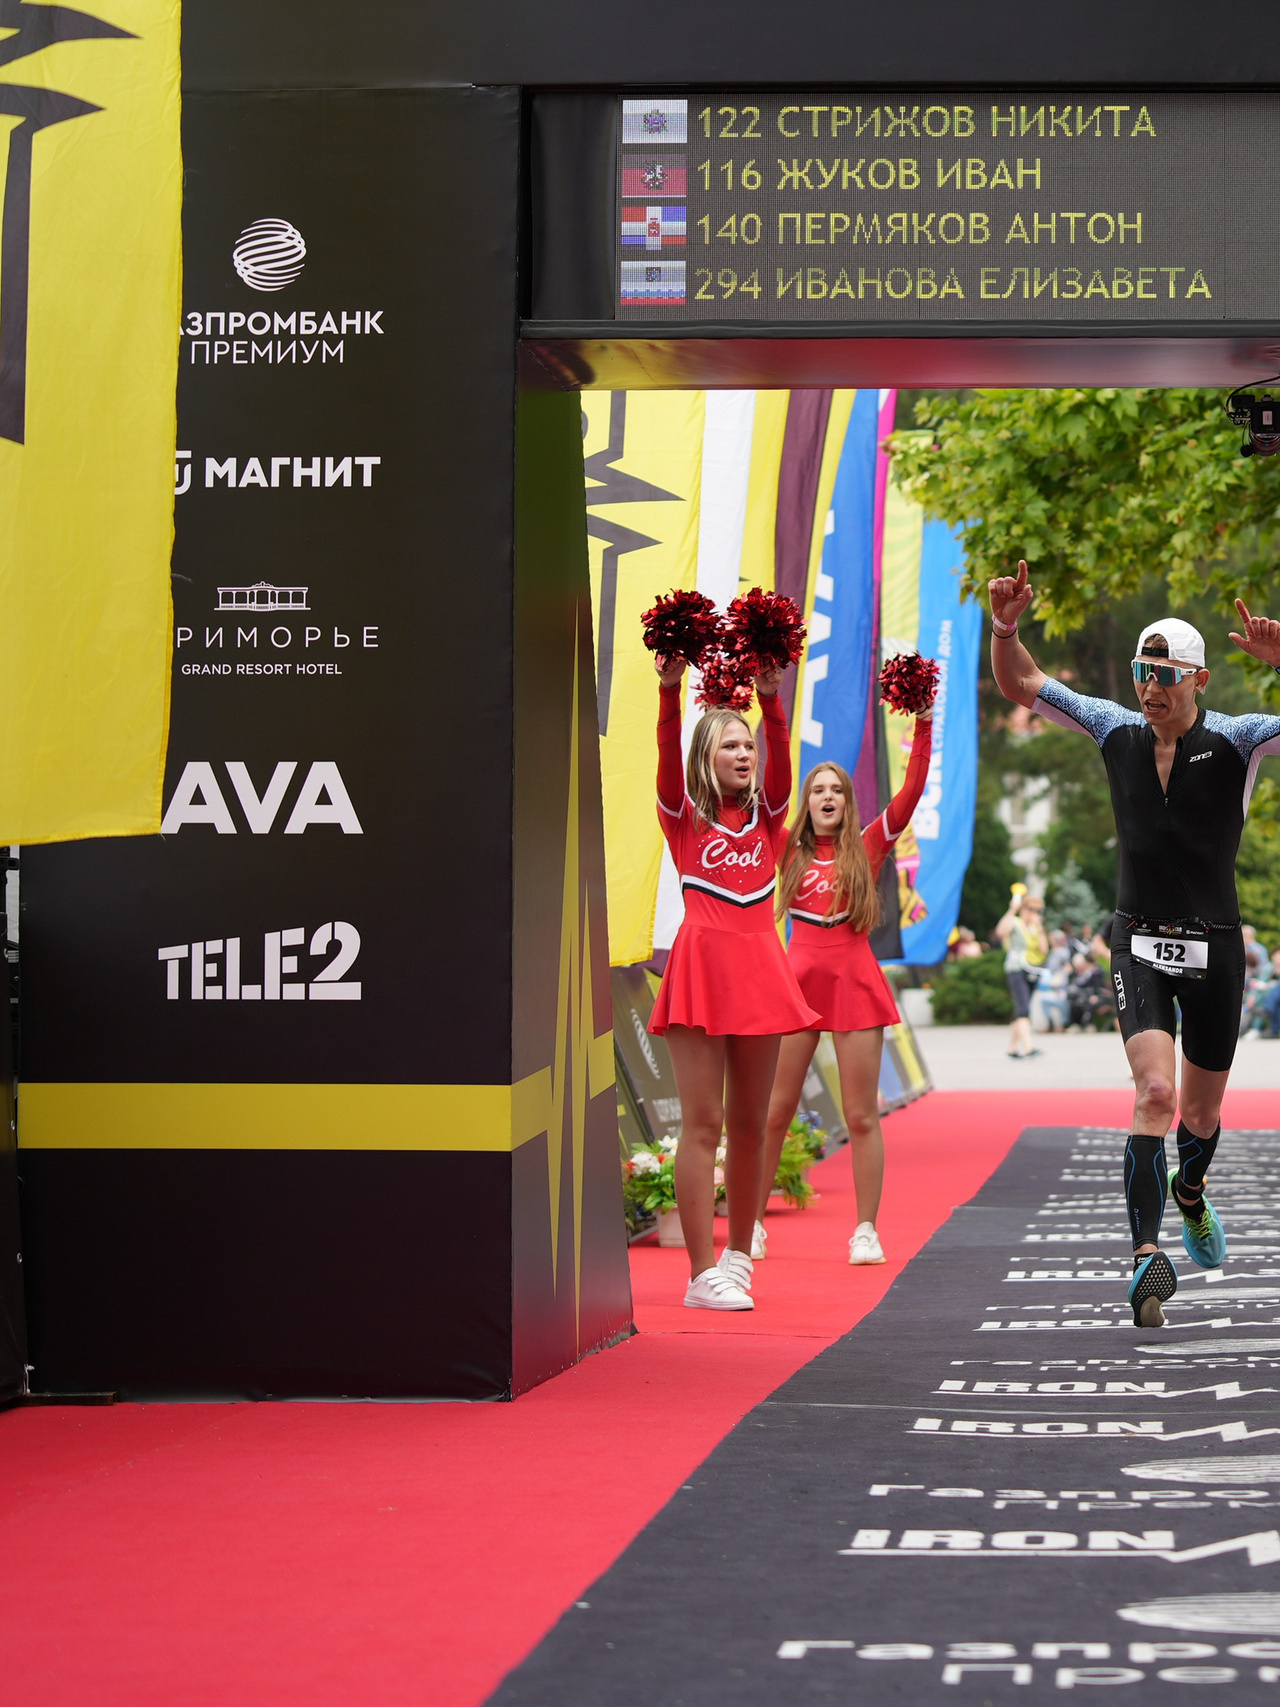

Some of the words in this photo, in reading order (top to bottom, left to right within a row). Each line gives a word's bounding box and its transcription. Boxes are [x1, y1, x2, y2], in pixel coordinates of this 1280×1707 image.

[696, 106, 762, 138] 122
[776, 105, 975, 138] СТРИЖОВ
[991, 104, 1156, 137] НИКИТА
[696, 159, 762, 191] 116
[776, 159, 921, 191] ЖУКОВ
[935, 158, 1042, 190] ИВАН
[697, 213, 762, 245] 140
[777, 213, 991, 245] ПЕРМЯКОВ
[1005, 212, 1143, 244] АНТОН
[694, 268, 762, 300] 294
[775, 267, 964, 300] ИВАНОВА
[980, 267, 1213, 299] ЕЛИЗАВЕТА
[178, 310, 385, 336] ЗПРОМБАНК
[190, 340, 345, 365] ПРЕМИУМ
[204, 456, 381, 488] МАГНИТ
[176, 626, 380, 649] РИМОРЬЕ
[181, 663, 232, 676] GRAND
[236, 663, 292, 676] RESORT
[296, 663, 342, 676] HOTEL
[160, 761, 364, 834] AVA
[701, 838, 762, 869] Cool
[158, 921, 362, 1000] TELE2
[1153, 942, 1186, 962] 152
[1152, 963, 1184, 974] ALEKSANDR
[1006, 1270, 1135, 1279] IRO
[938, 1379, 1167, 1393] IRON
[913, 1417, 1164, 1434] IRON
[850, 1529, 1176, 1551] IRON
